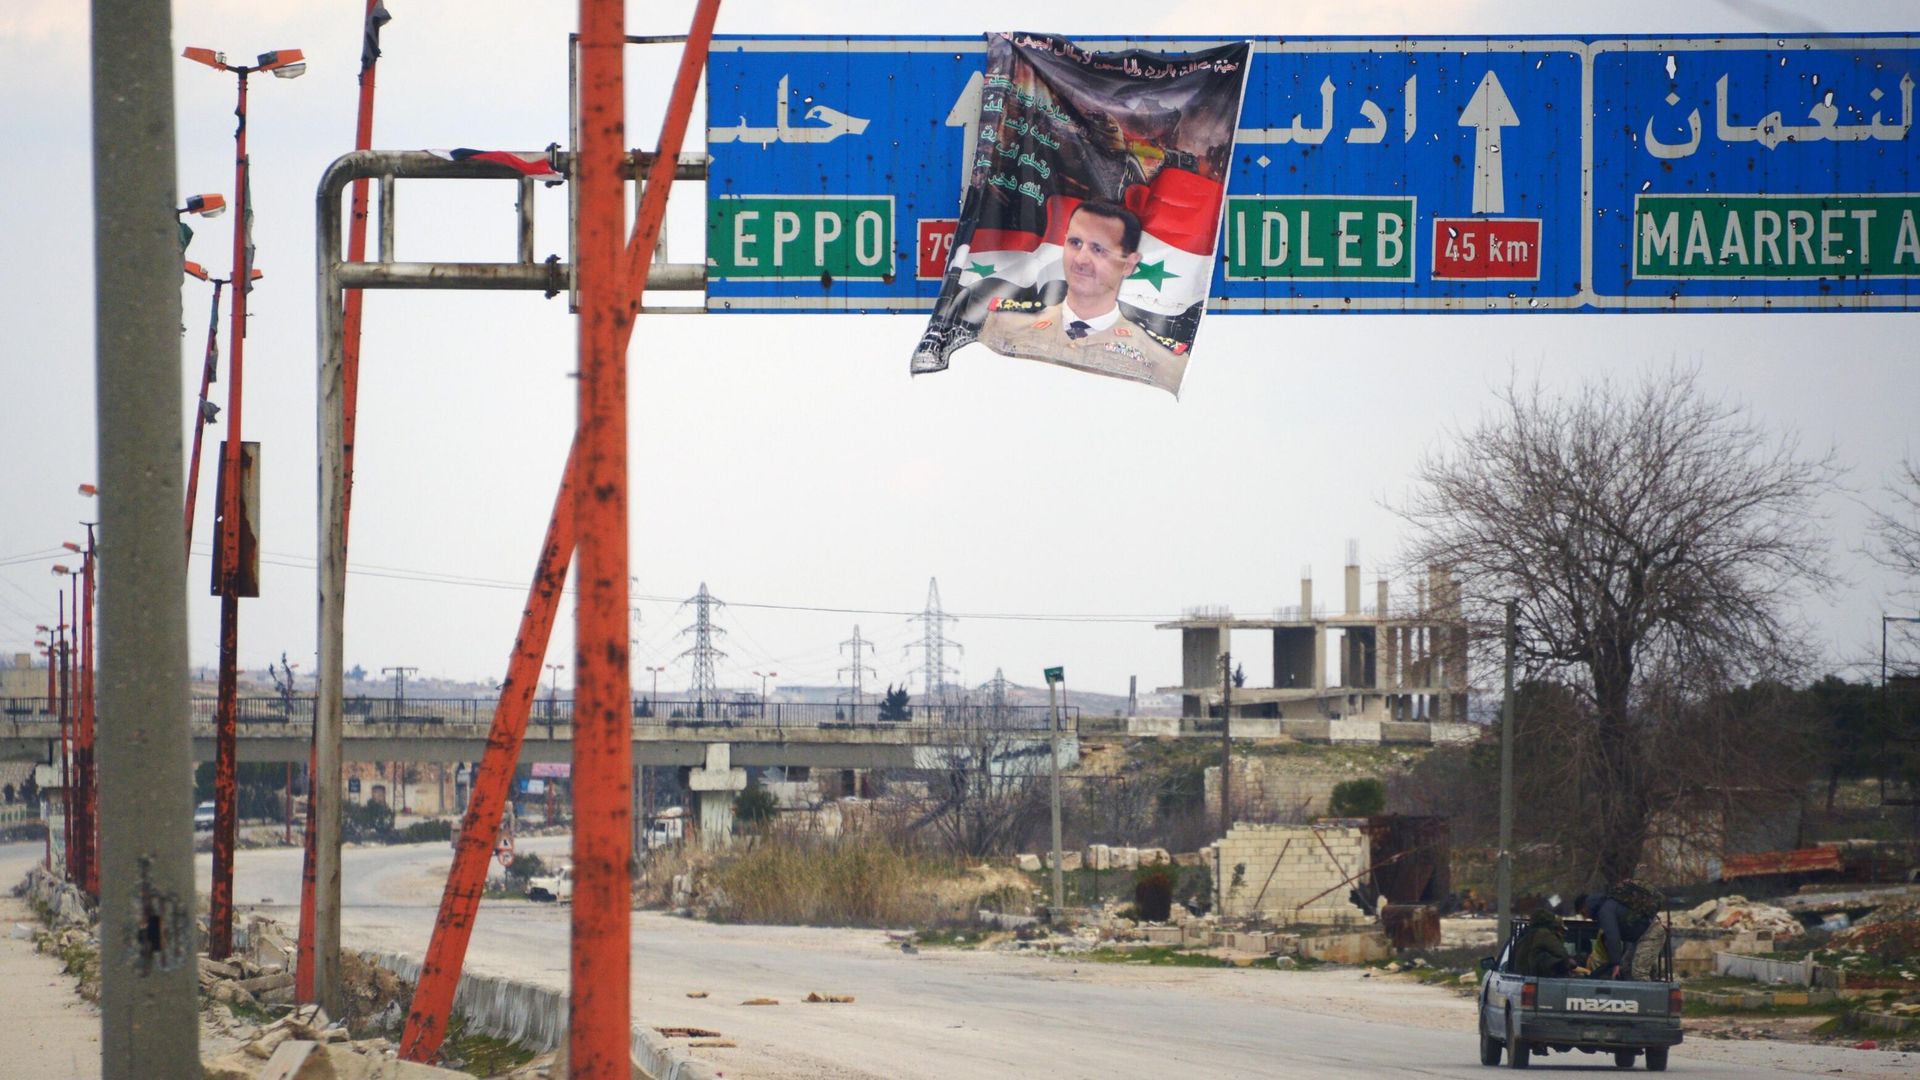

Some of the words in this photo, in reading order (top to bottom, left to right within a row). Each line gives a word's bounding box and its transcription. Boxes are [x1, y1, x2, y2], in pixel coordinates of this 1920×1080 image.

[708, 210, 883, 267] EPPO
[1237, 210, 1404, 267] IDLEB
[1444, 232, 1477, 263] 45
[1489, 232, 1528, 263] km
[1641, 209, 1877, 266] MAARRET
[1893, 209, 1920, 265] A
